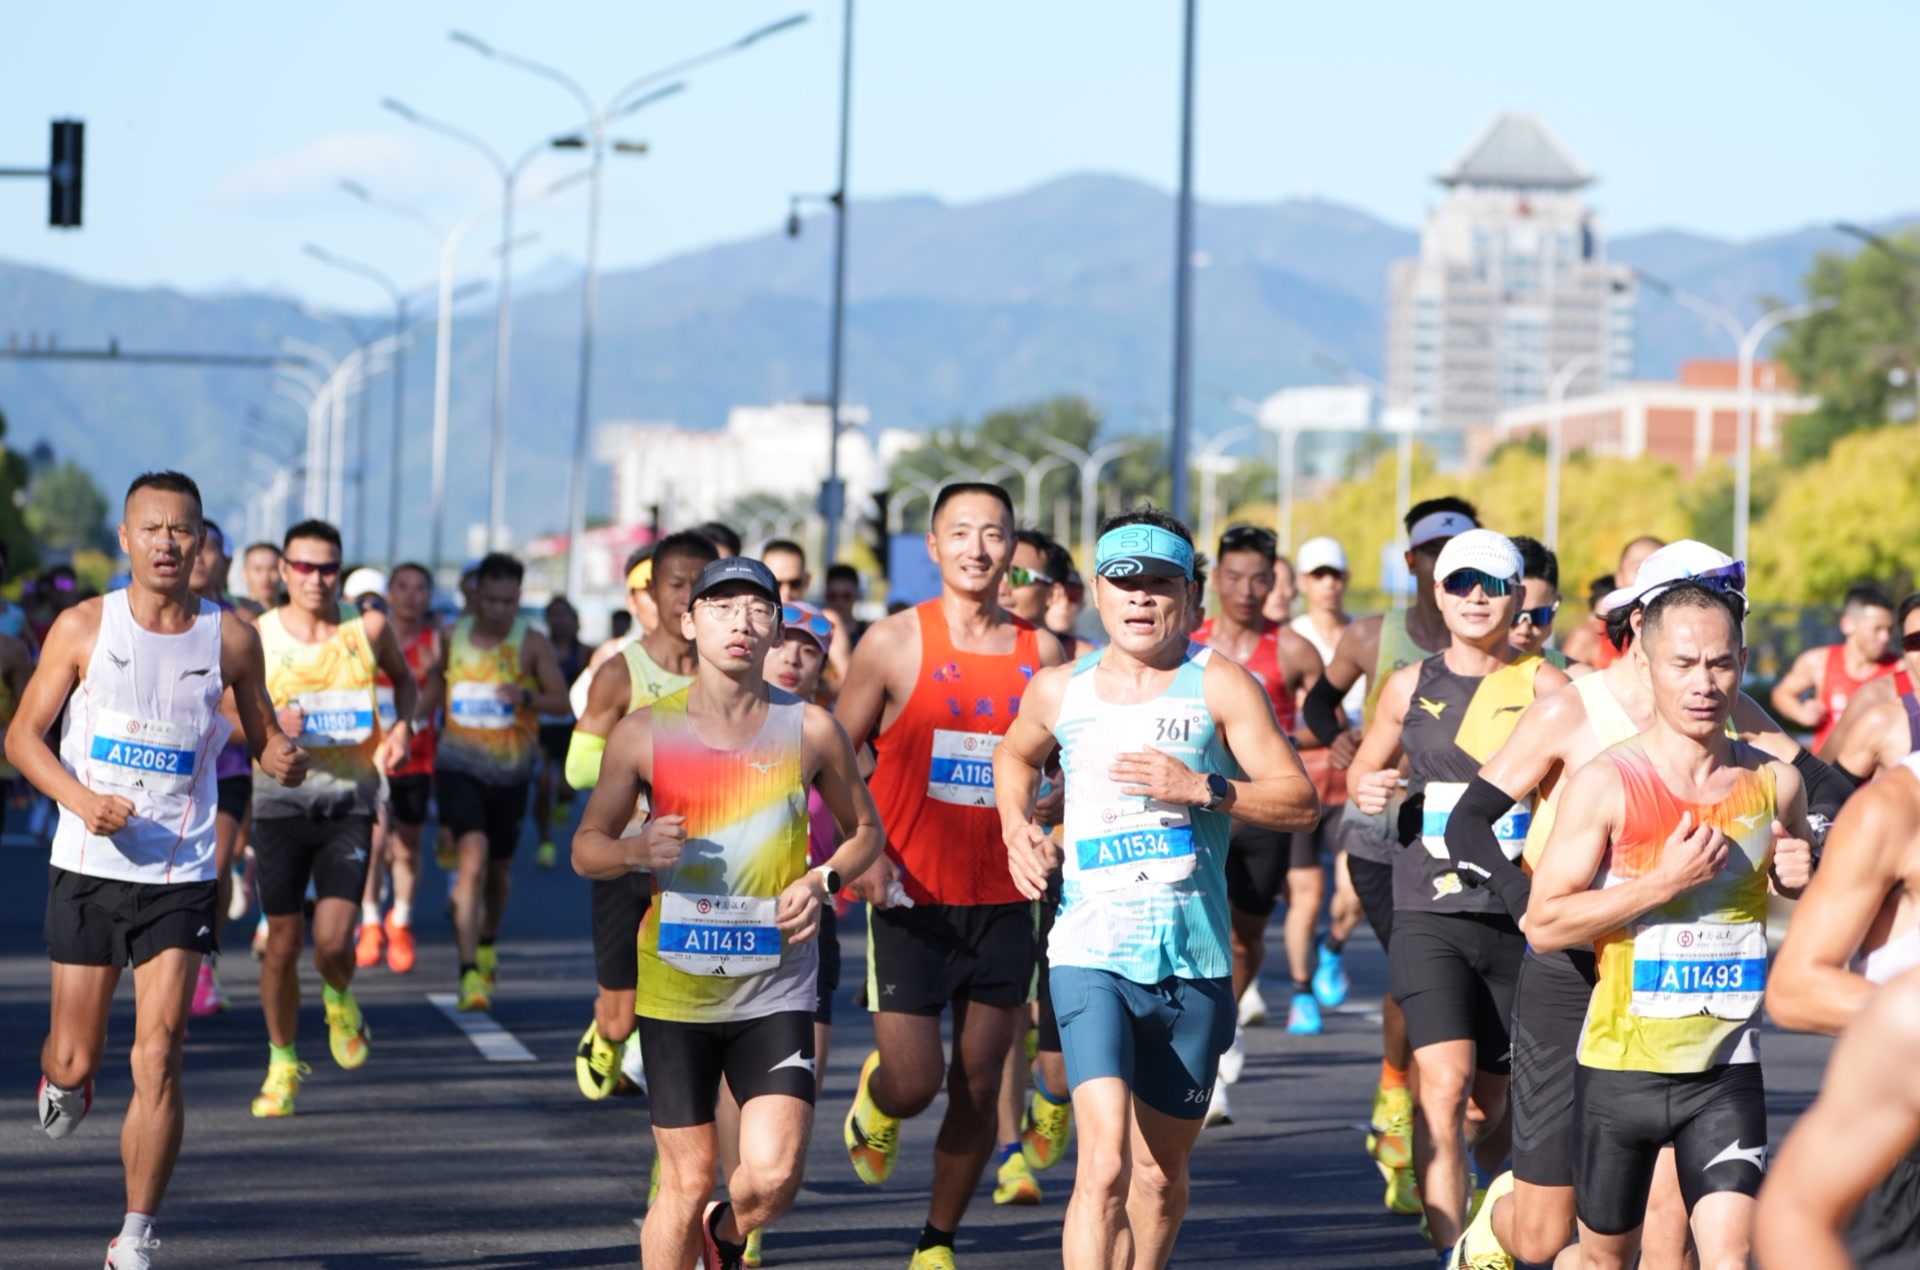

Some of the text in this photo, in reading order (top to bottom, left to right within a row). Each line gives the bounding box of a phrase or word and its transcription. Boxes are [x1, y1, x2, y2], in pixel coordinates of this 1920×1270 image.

[107, 743, 179, 772] A12062
[950, 763, 993, 785] A116
[1098, 833, 1170, 864] A11534
[684, 929, 756, 952] A11413
[1661, 964, 1743, 990] A11493
